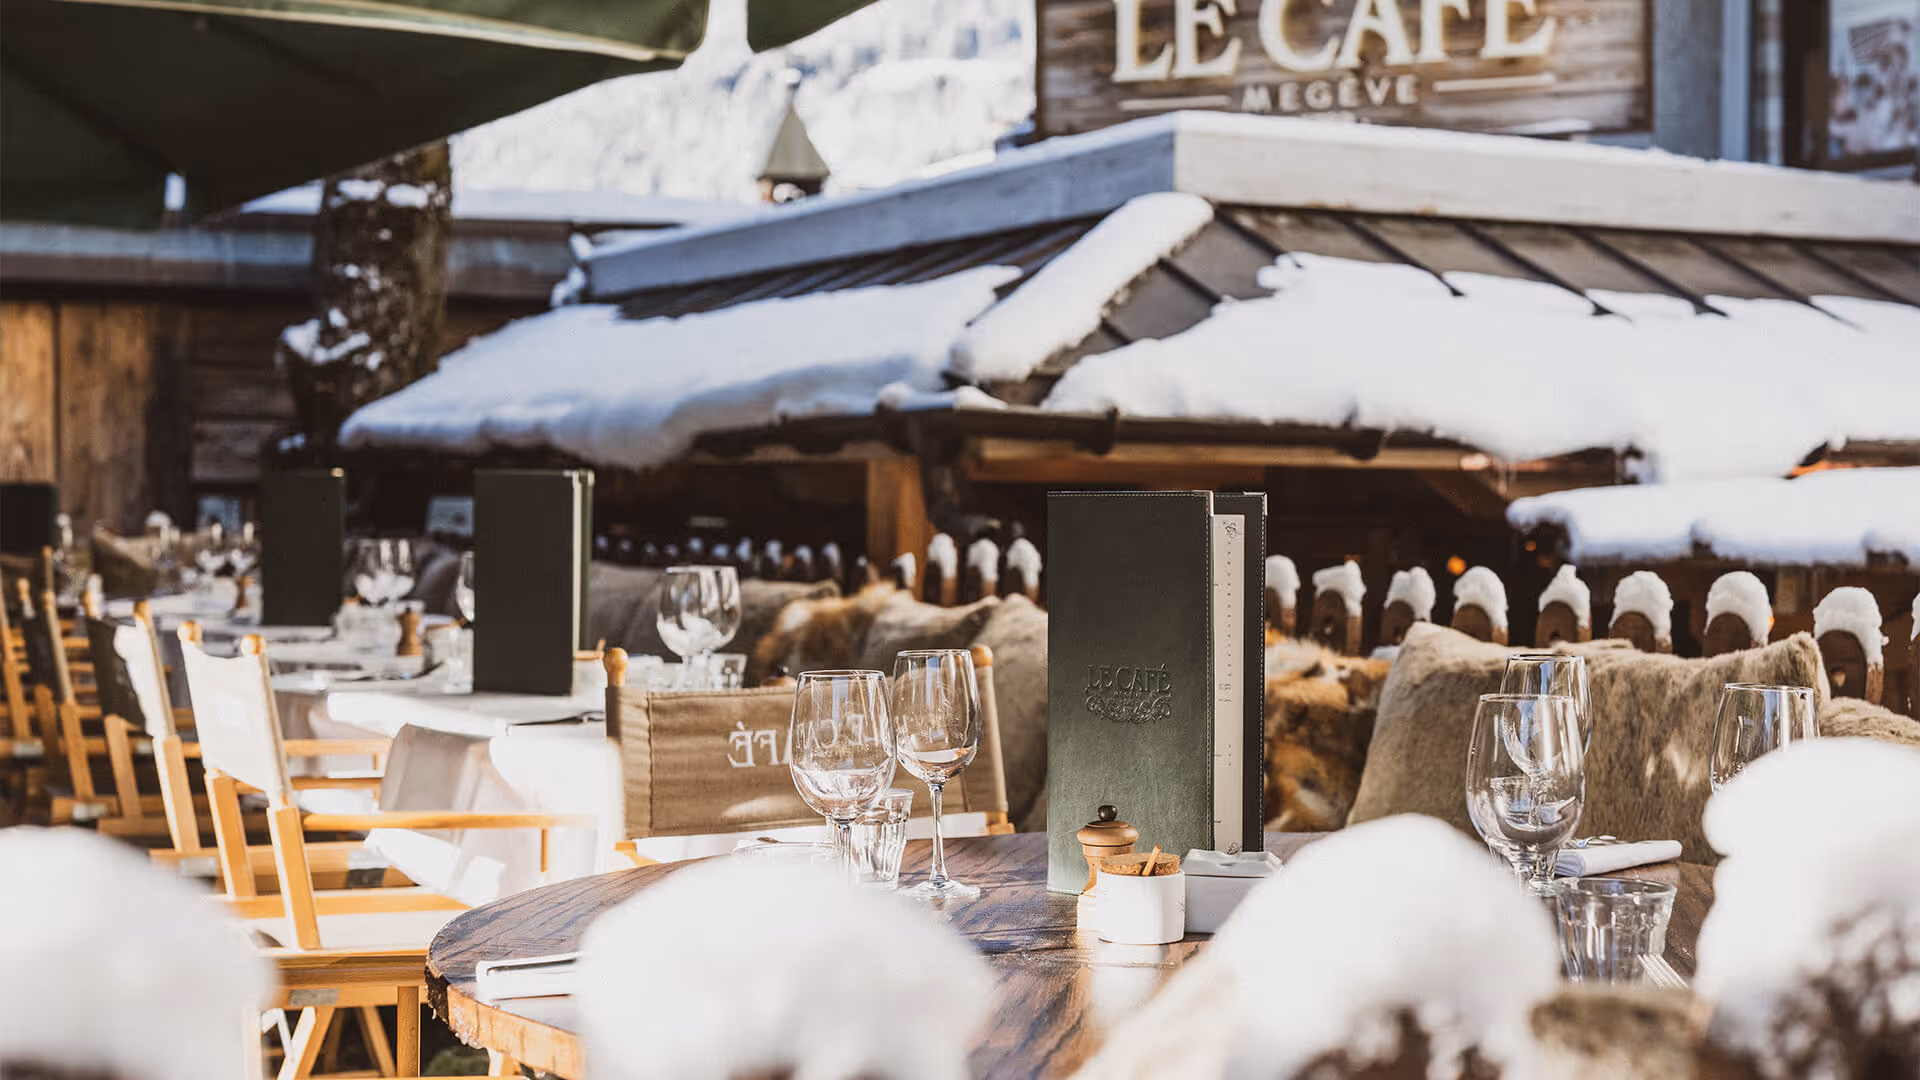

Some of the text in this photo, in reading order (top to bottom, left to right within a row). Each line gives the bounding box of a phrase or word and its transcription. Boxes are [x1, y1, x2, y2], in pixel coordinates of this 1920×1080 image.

[1112, 0, 1241, 81] LE
[1087, 663, 1172, 692] LE CAFÉ
